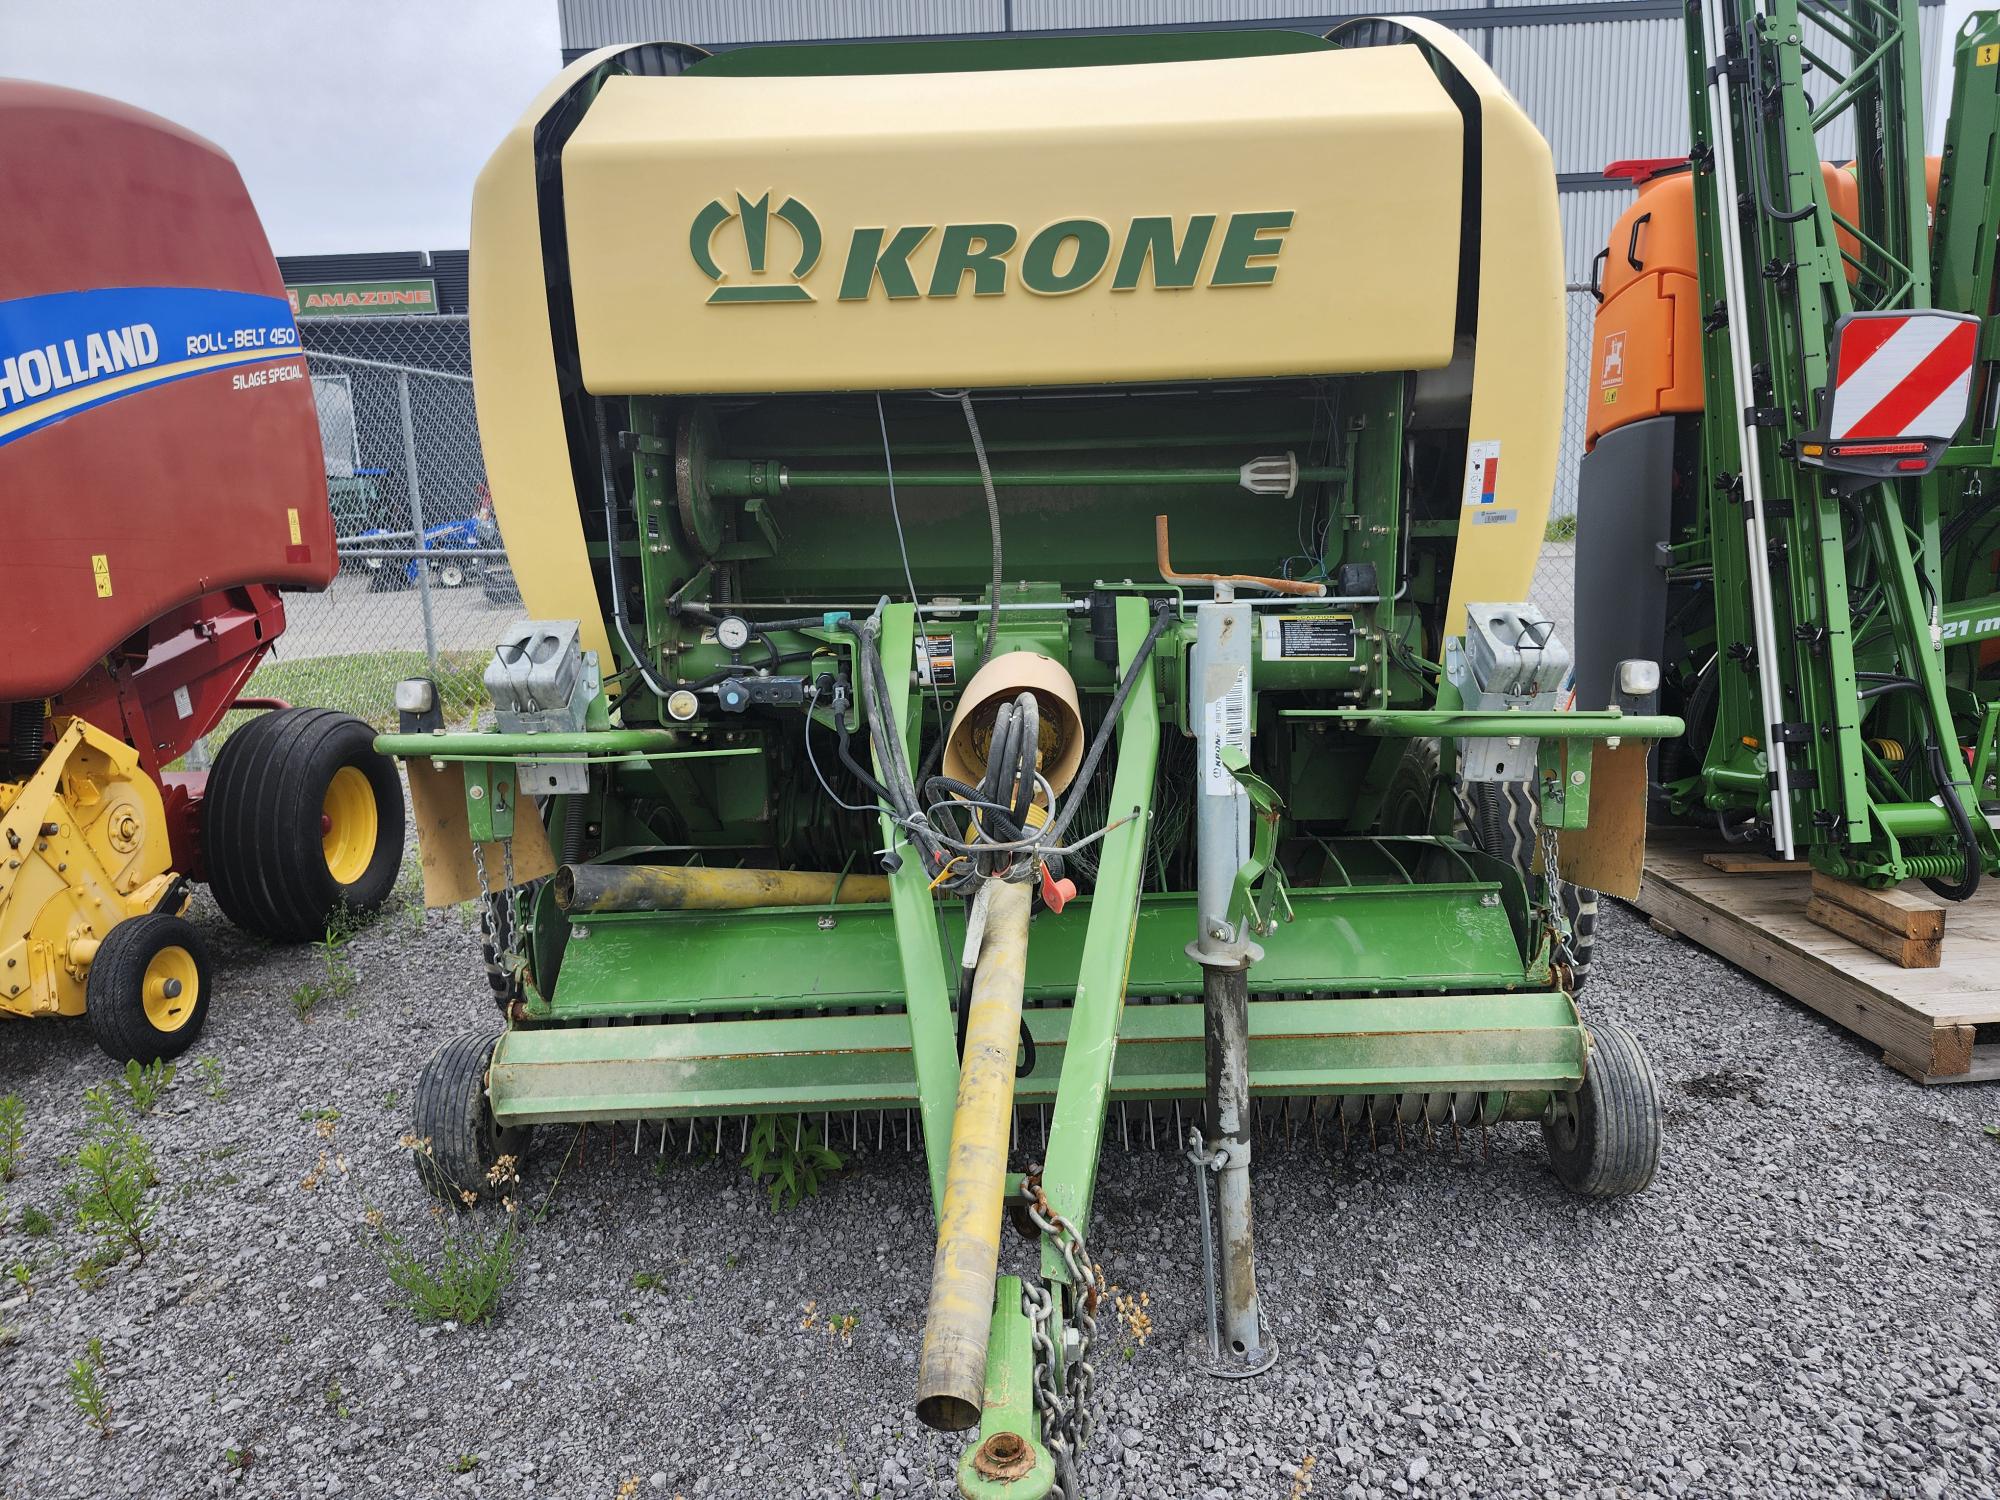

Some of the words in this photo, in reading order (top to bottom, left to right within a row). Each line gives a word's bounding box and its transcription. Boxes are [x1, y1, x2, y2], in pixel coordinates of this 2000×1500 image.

[837, 210, 1296, 301] KRONE
[305, 290, 432, 308] AMAZONE
[269, 328, 295, 345] 450
[0, 323, 158, 409] HOLLAND
[233, 370, 267, 390] SILAGE
[268, 365, 303, 384] SPECIAL
[1942, 620, 1969, 639] 21
[1975, 616, 2000, 634] m
